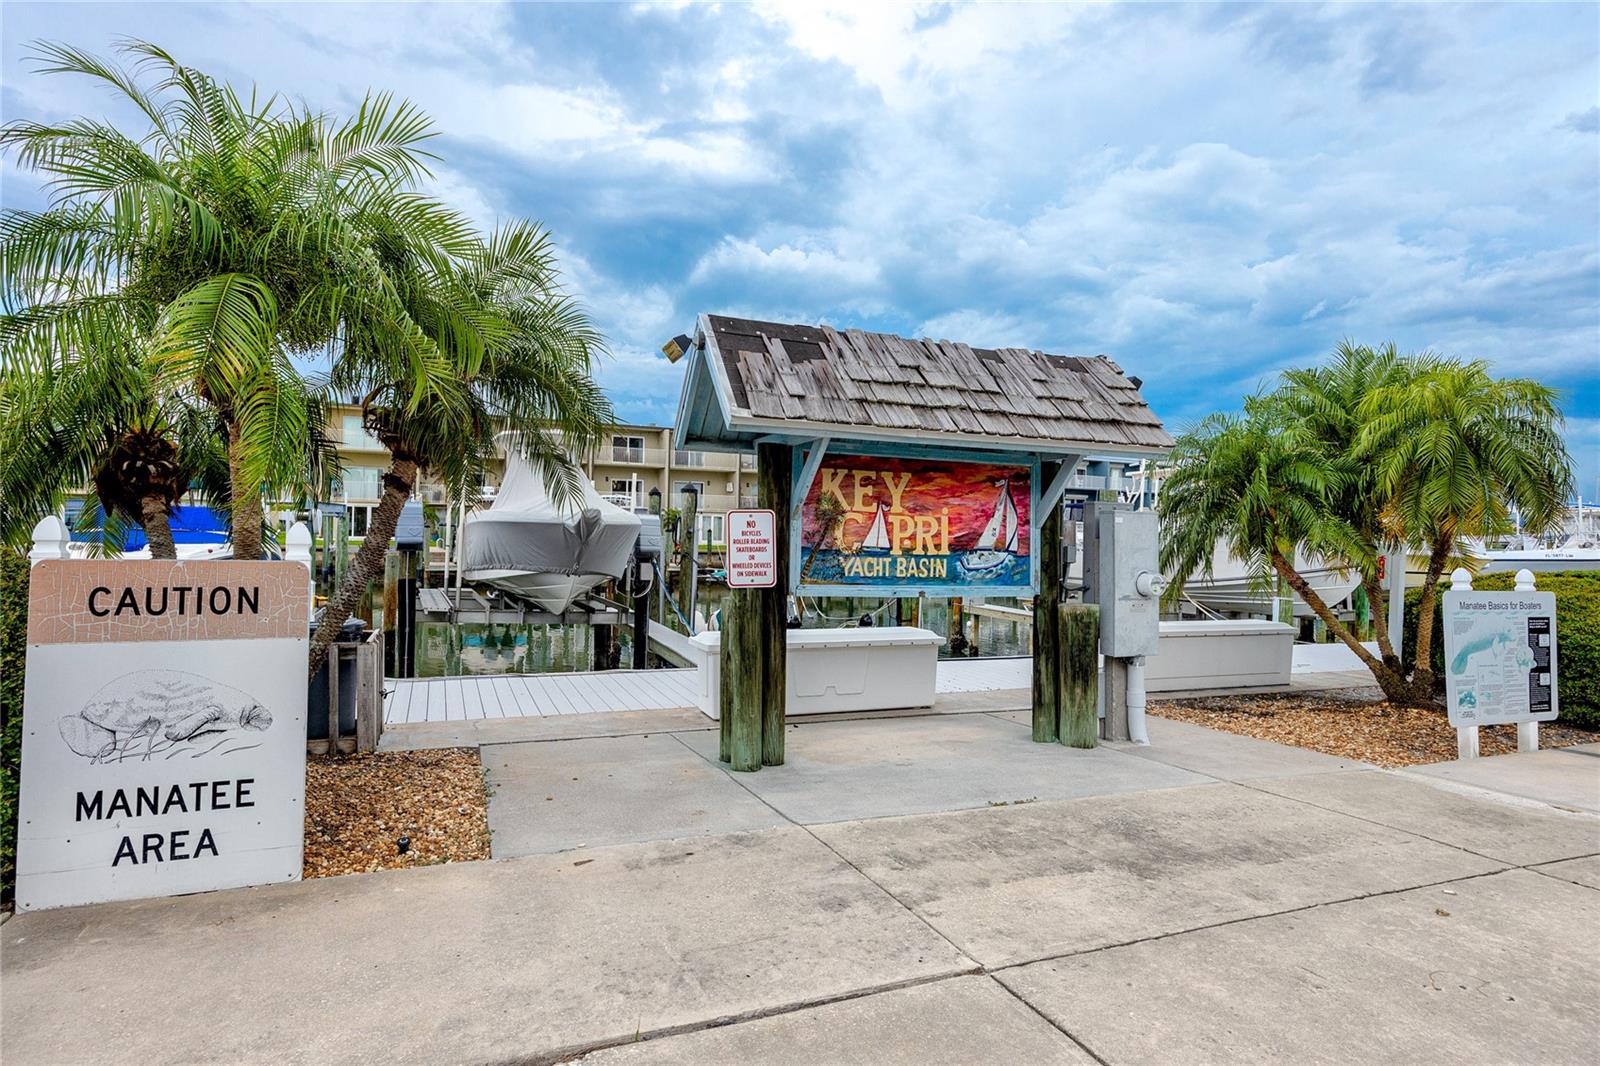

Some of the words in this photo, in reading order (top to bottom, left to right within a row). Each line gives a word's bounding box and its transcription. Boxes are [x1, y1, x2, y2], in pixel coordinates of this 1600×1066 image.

[820, 468, 912, 514] KEY
[746, 520, 756, 529] NO
[839, 557, 892, 577] YACHT
[896, 558, 948, 578] BASIN
[87, 586, 260, 617] CAUTION
[1459, 601, 1487, 610] Manatee
[1488, 601, 1509, 610] Basics
[1510, 601, 1518, 610] for
[1519, 601, 1542, 610] Boaters
[75, 778, 255, 822] MANATEE
[111, 828, 219, 867] AREA
